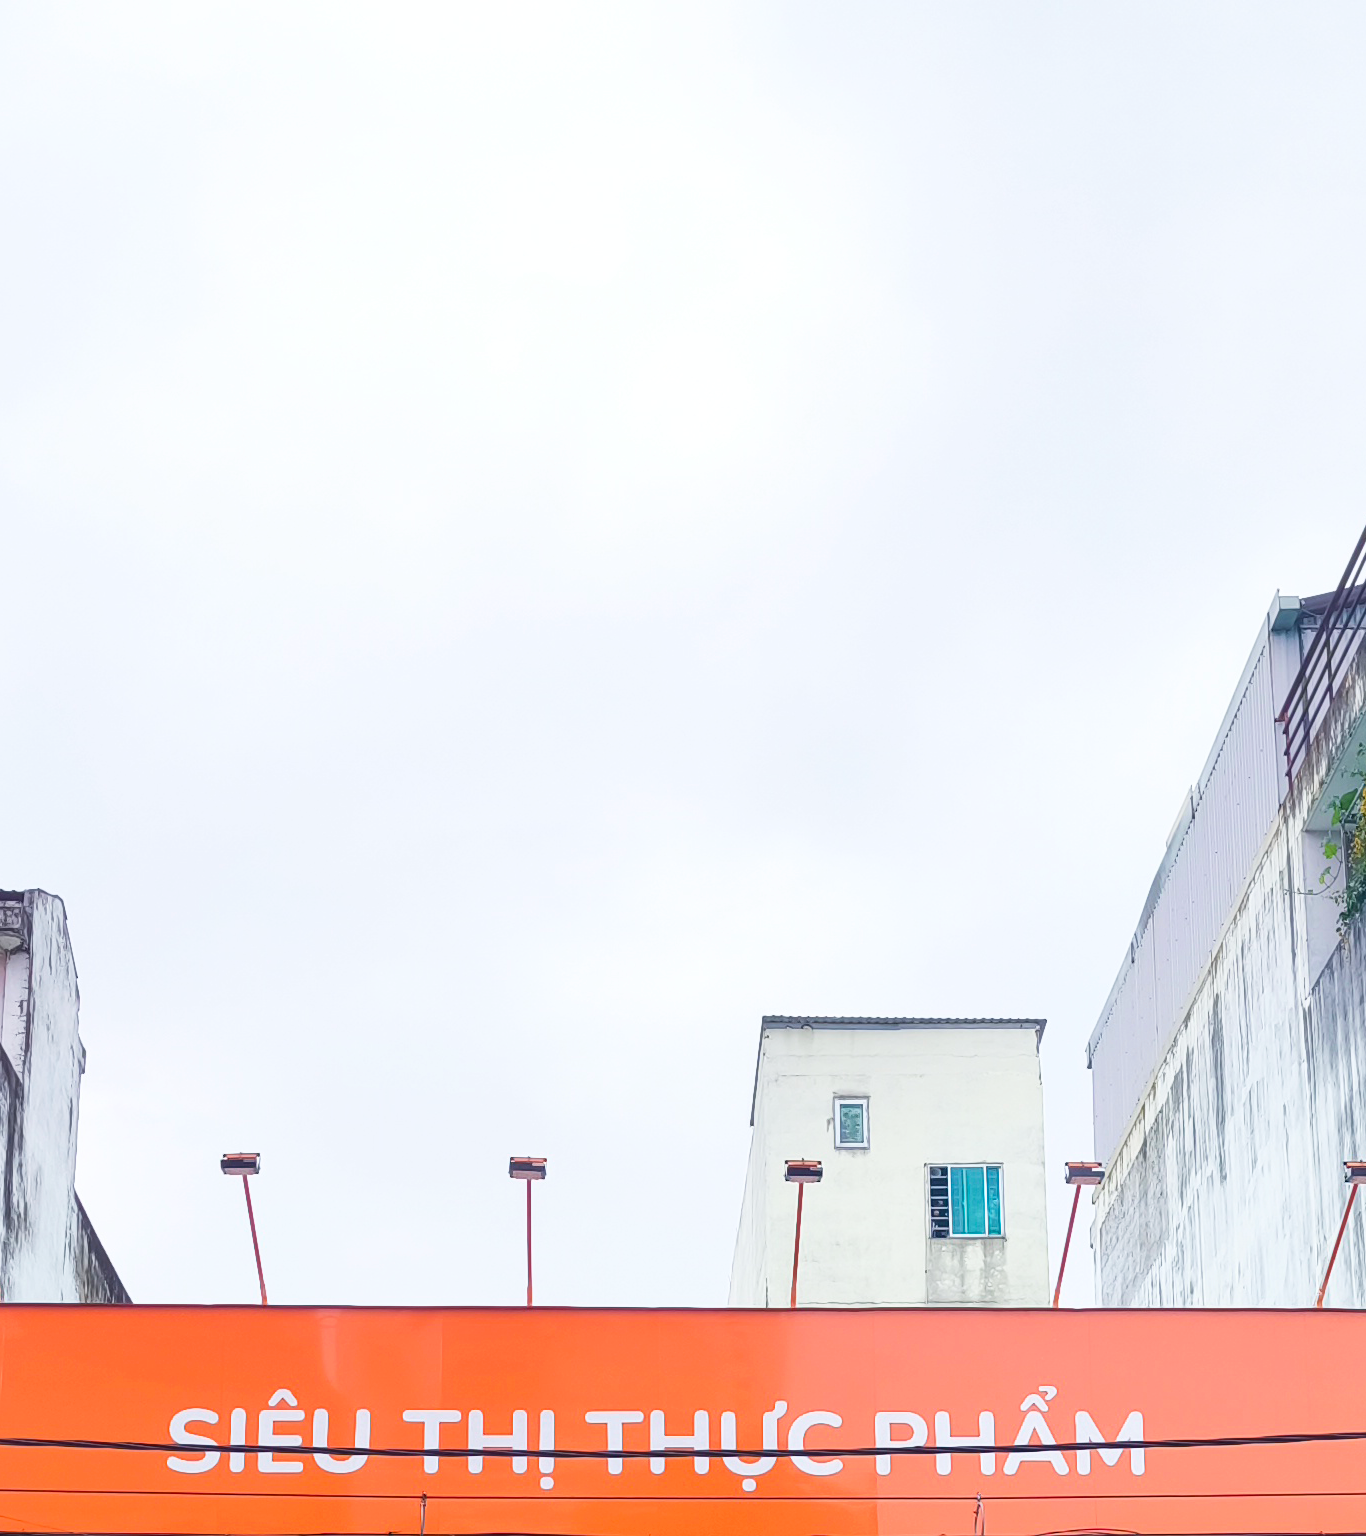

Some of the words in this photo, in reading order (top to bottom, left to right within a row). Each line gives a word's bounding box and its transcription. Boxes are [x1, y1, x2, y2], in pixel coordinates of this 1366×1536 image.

[166, 1388, 372, 1475] SIÊU
[402, 1409, 557, 1490] THỊ
[585, 1400, 843, 1491] THỰC
[875, 1385, 1147, 1476] PHẨM
